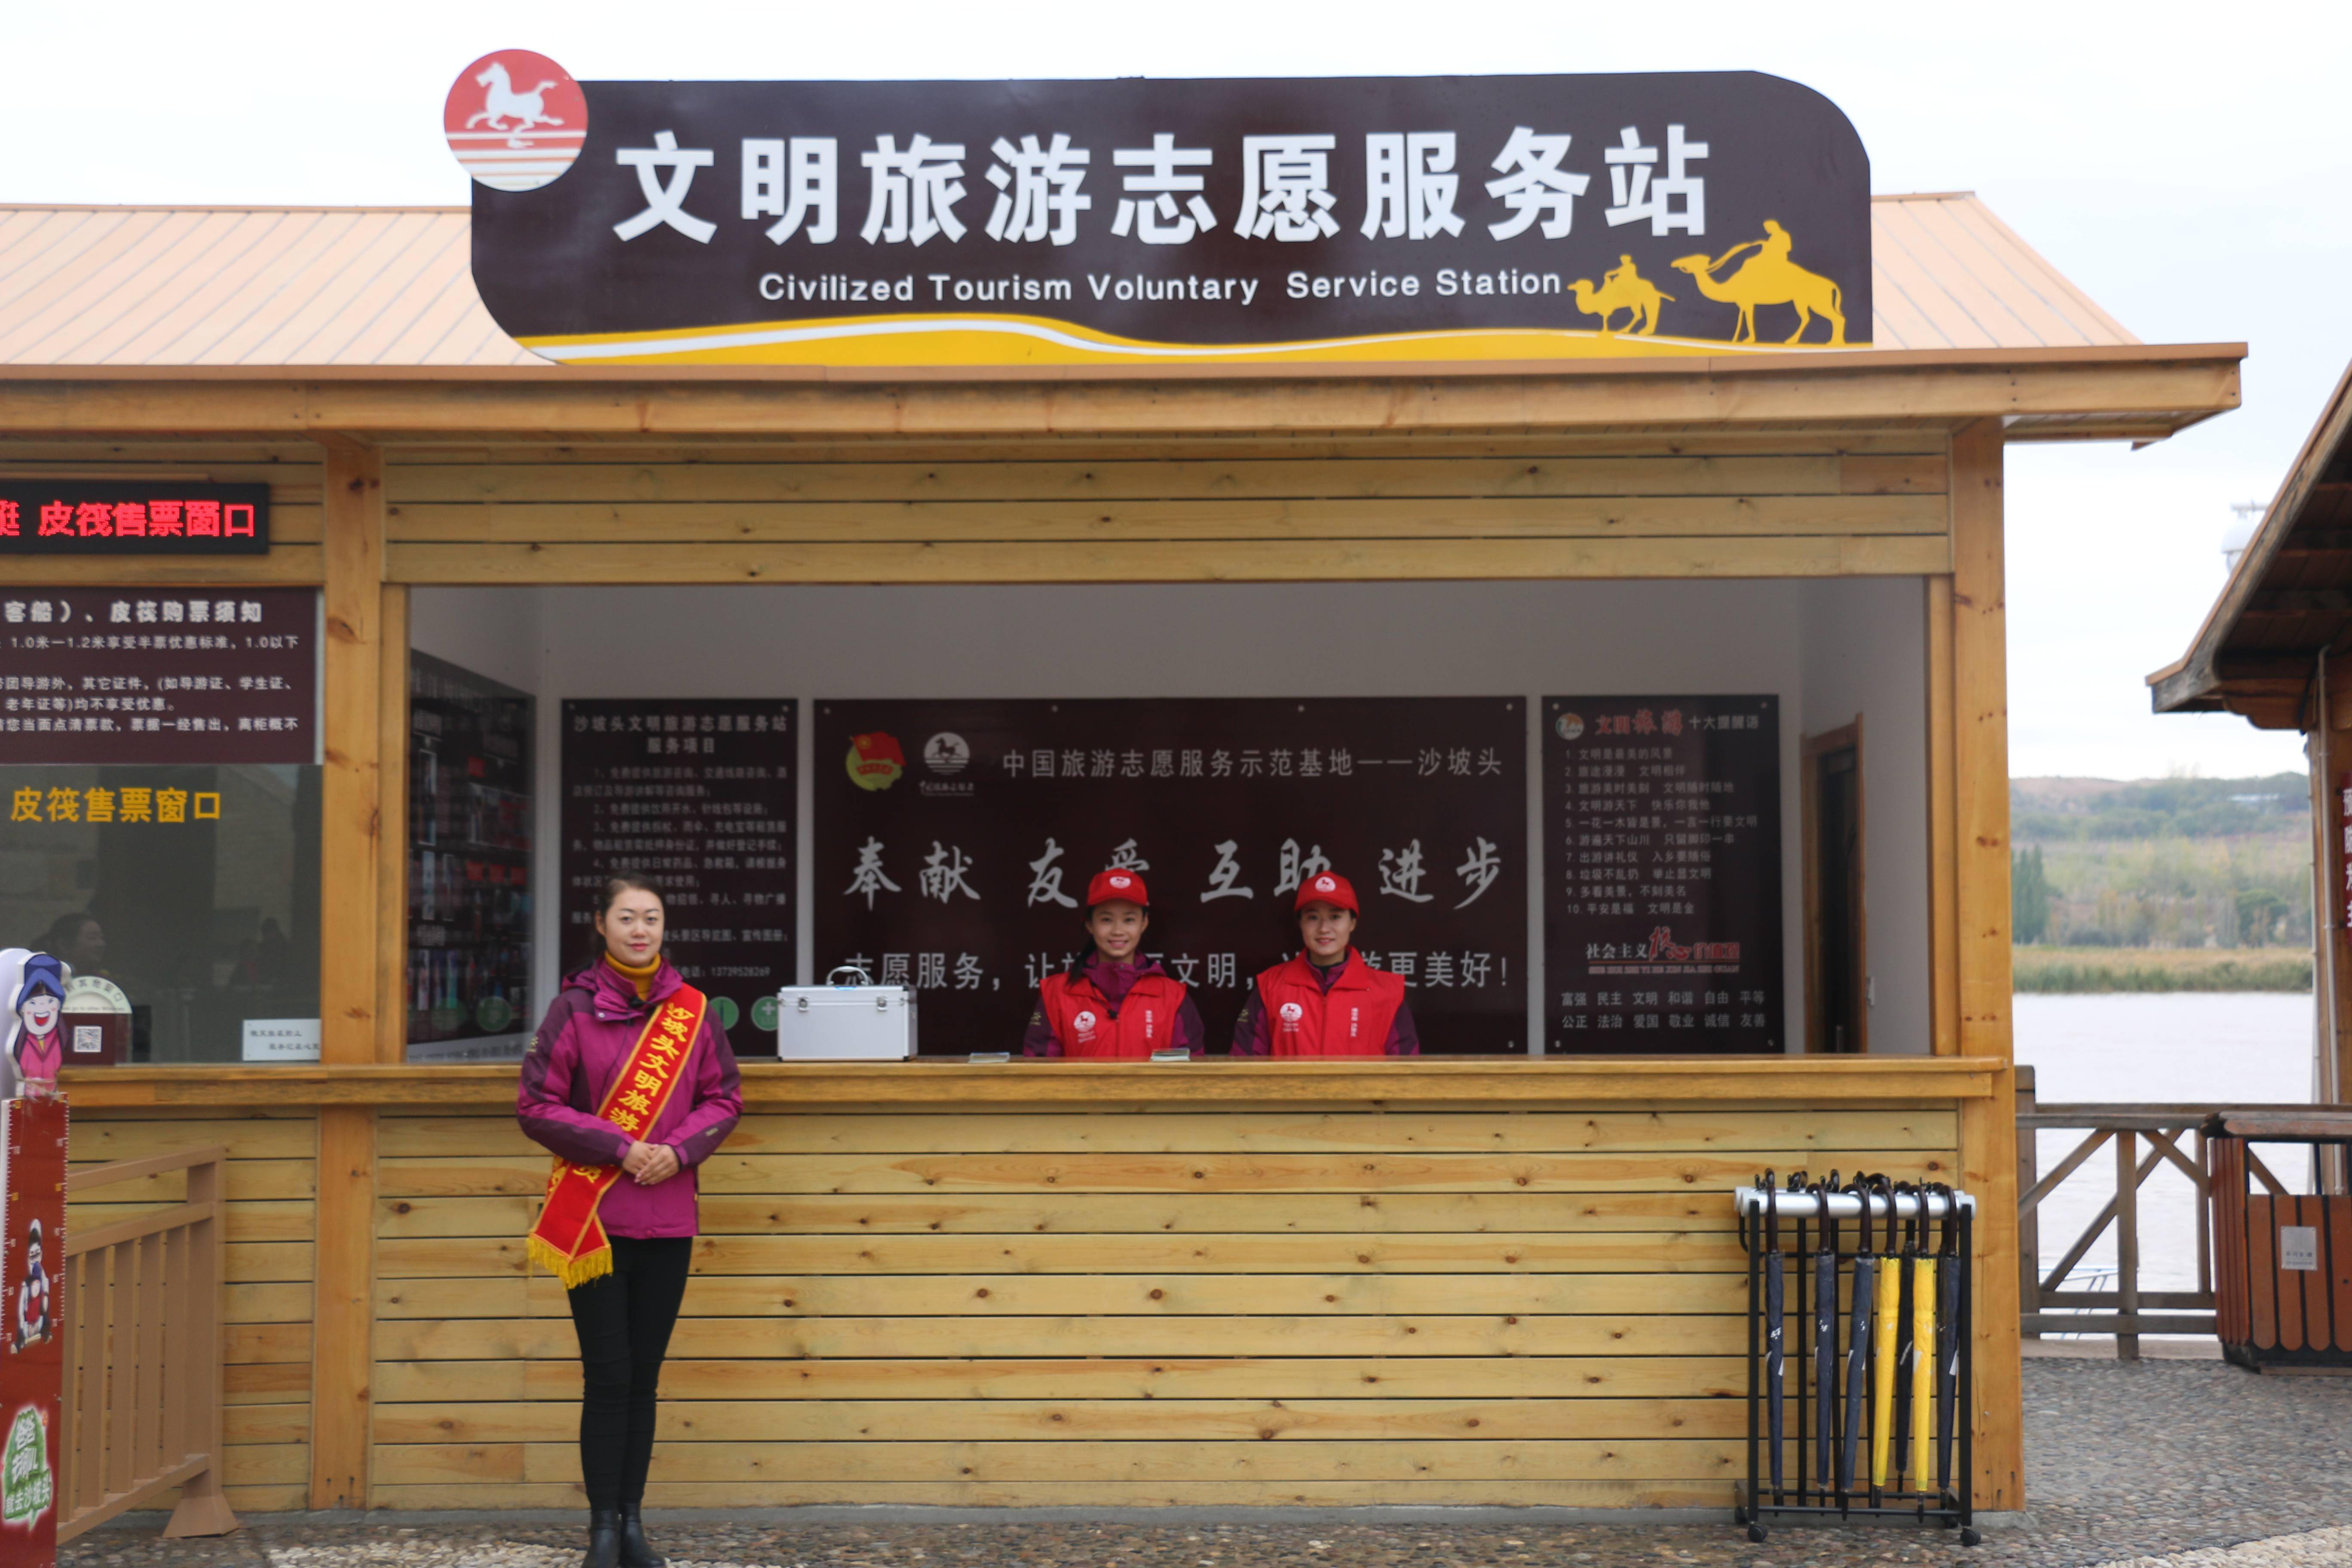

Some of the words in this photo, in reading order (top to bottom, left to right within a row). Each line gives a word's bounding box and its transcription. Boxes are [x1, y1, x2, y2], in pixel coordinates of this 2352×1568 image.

[613, 124, 1709, 247] 文明旅游志愿服务站
[760, 273, 913, 301] Civilized
[928, 275, 1072, 300] Tourism
[1087, 274, 1258, 305] Voluntary
[1286, 270, 1420, 298] Service
[1436, 269, 1560, 296] Station
[37, 499, 254, 537] 皮筏售票窗口
[0, 717, 298, 732] 您当面点清票款，票据一经售出，离柜概不
[11, 786, 220, 823] 皮筏售票窗口
[844, 836, 981, 911] 奉献
[1378, 836, 1501, 909] 进步
[1562, 992, 1586, 1005] 富强
[1597, 992, 1623, 1005] 民主
[1632, 992, 1657, 1005] 文明
[1705, 991, 1728, 1005] 自由
[1740, 990, 1764, 1004] 平等
[1562, 1015, 1587, 1029] 公正
[1598, 1015, 1623, 1029] 法治
[1633, 1014, 1659, 1029] 爱国
[1740, 1014, 1765, 1028] 友善
[609, 1003, 695, 1131] 沙坡头文明旅游
[15, 1415, 35, 1451] 爸爸
[12, 1447, 38, 1486] 去哪儿
[6, 1472, 50, 1515] 就去沙坡头
